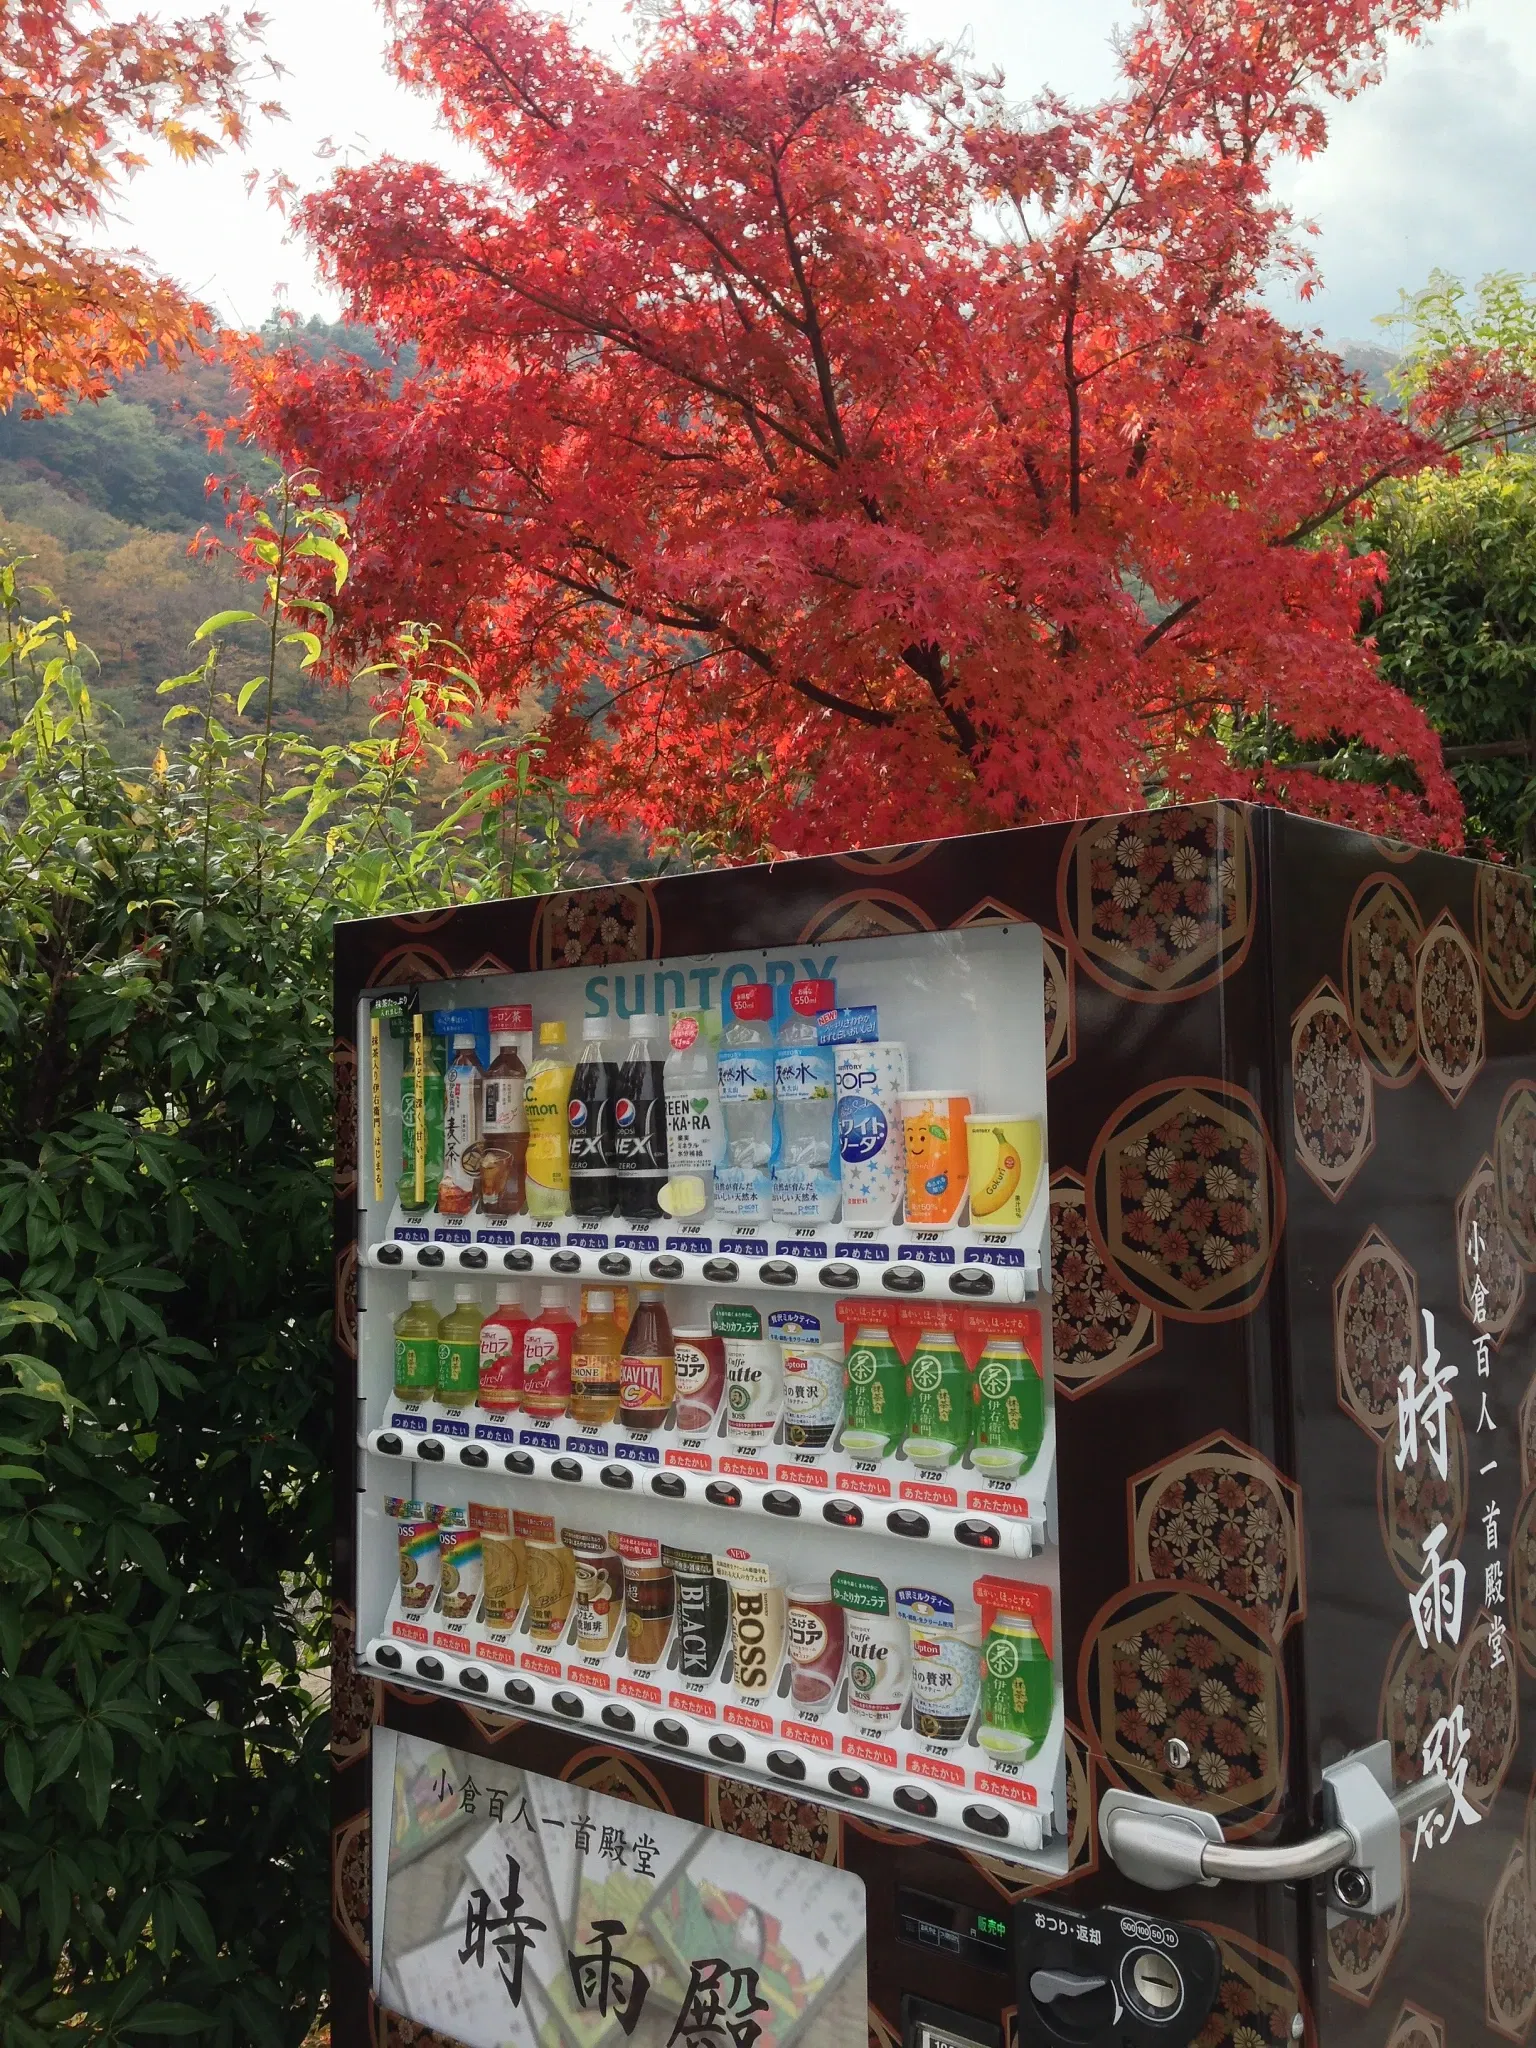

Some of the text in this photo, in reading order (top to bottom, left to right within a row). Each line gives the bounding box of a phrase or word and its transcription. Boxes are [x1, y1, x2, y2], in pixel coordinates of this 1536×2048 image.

[490, 1011, 522, 1023] ーロン茶
[525, 1103, 558, 1117] emon
[986, 1167, 1006, 1195] Gokuri
[397, 1232, 426, 1240] つめたい
[736, 1227, 755, 1235] ¥110
[795, 1228, 815, 1237] ¥110
[853, 1230, 874, 1239] ¥120
[916, 1232, 938, 1241] ¥120
[438, 1234, 468, 1242] つめたい
[480, 1235, 511, 1244] つめたい
[524, 1236, 557, 1245] つめたい
[569, 1238, 605, 1247] つめたい
[983, 1234, 1007, 1243] ¥120
[618, 1240, 655, 1250] つめたい
[670, 1242, 708, 1252] つめたい
[724, 1244, 764, 1254] つめたい
[780, 1246, 823, 1257] つめたい
[840, 1248, 885, 1259] つめたい
[903, 1251, 950, 1262] つめたい
[969, 1252, 1019, 1264] つめたい
[771, 1313, 816, 1326] 贅沢ミルクティー
[712, 1321, 759, 1333] ゆったりカフェラテ
[481, 1338, 508, 1354] セロラ
[480, 1372, 503, 1386] efresh
[405, 1404, 420, 1412] ¥120
[446, 1409, 461, 1417] ¥120
[394, 1418, 424, 1429] つめたい
[489, 1414, 505, 1422] ¥120
[435, 1424, 466, 1434] つめたい
[534, 1420, 550, 1429] ¥120
[478, 1430, 511, 1440] つめたい
[581, 1426, 598, 1435] ¥120
[523, 1436, 556, 1447] つめたい
[630, 1433, 648, 1441] ¥120
[570, 1442, 605, 1454] つめたい
[682, 1439, 701, 1448] ¥120
[1466, 1220, 1507, 1671] 小倉百人一首殿堂
[619, 1449, 656, 1461] つめたい
[737, 1446, 756, 1456] ¥120
[669, 1455, 707, 1468] あたたかい
[794, 1453, 815, 1464] ¥120
[723, 1462, 764, 1475] あたたかい
[856, 1462, 877, 1472] ¥120
[780, 1470, 823, 1484] あたたかい
[919, 1470, 942, 1481] ¥120
[841, 1478, 887, 1493] あたたかい
[988, 1480, 1012, 1490] ¥120
[904, 1487, 952, 1503] あたたかい
[972, 1497, 1022, 1514] あたたかい
[398, 1527, 415, 1537] OSS
[439, 1534, 457, 1545] OSS
[729, 1549, 748, 1560] NEW
[1395, 1309, 1483, 1863] 時雨殿
[833, 1587, 887, 1608] ゆったりカフェラテ
[898, 1590, 950, 1608] 贅沢ミルクティー
[405, 1613, 420, 1622] ¥120
[395, 1626, 425, 1640] あたたかい
[447, 1623, 462, 1632] ¥120
[680, 1583, 708, 1672] BLACK
[436, 1636, 468, 1650] あたたかい
[490, 1633, 506, 1643] ¥120
[737, 1592, 767, 1688] BOSS
[479, 1647, 512, 1662] あたたかい
[535, 1644, 552, 1654] ¥120
[524, 1658, 558, 1674] あたたかい
[582, 1656, 600, 1666] ¥120
[632, 1668, 651, 1679] ¥120
[571, 1672, 606, 1687] あたたかい
[620, 1684, 657, 1700] あたたかい
[685, 1682, 704, 1693] ¥120
[672, 1699, 712, 1715] あたたかい
[740, 1696, 760, 1707] ¥120
[727, 1713, 769, 1729] あたたかい
[798, 1711, 819, 1722] ¥120
[785, 1729, 829, 1746] あたたかい
[860, 1727, 882, 1739] ¥120
[846, 1743, 892, 1763] あたたかい
[925, 1744, 948, 1757] ¥120
[911, 1760, 960, 1781] あたたかい
[993, 1761, 1018, 1775] ¥120
[979, 1778, 1031, 1801] あたたかい
[432, 1768, 661, 1880] 小倉百人一首殿堂
[970, 1927, 977, 1937] 円
[977, 1915, 1006, 1938] 販売中
[1034, 1913, 1102, 1946] おつり・返却
[1122, 1921, 1136, 1933] 500
[1137, 1925, 1150, 1936] 100
[1151, 1930, 1162, 1940] 50
[1165, 1934, 1175, 1943] 10
[458, 1854, 770, 2048] 時雨殿
